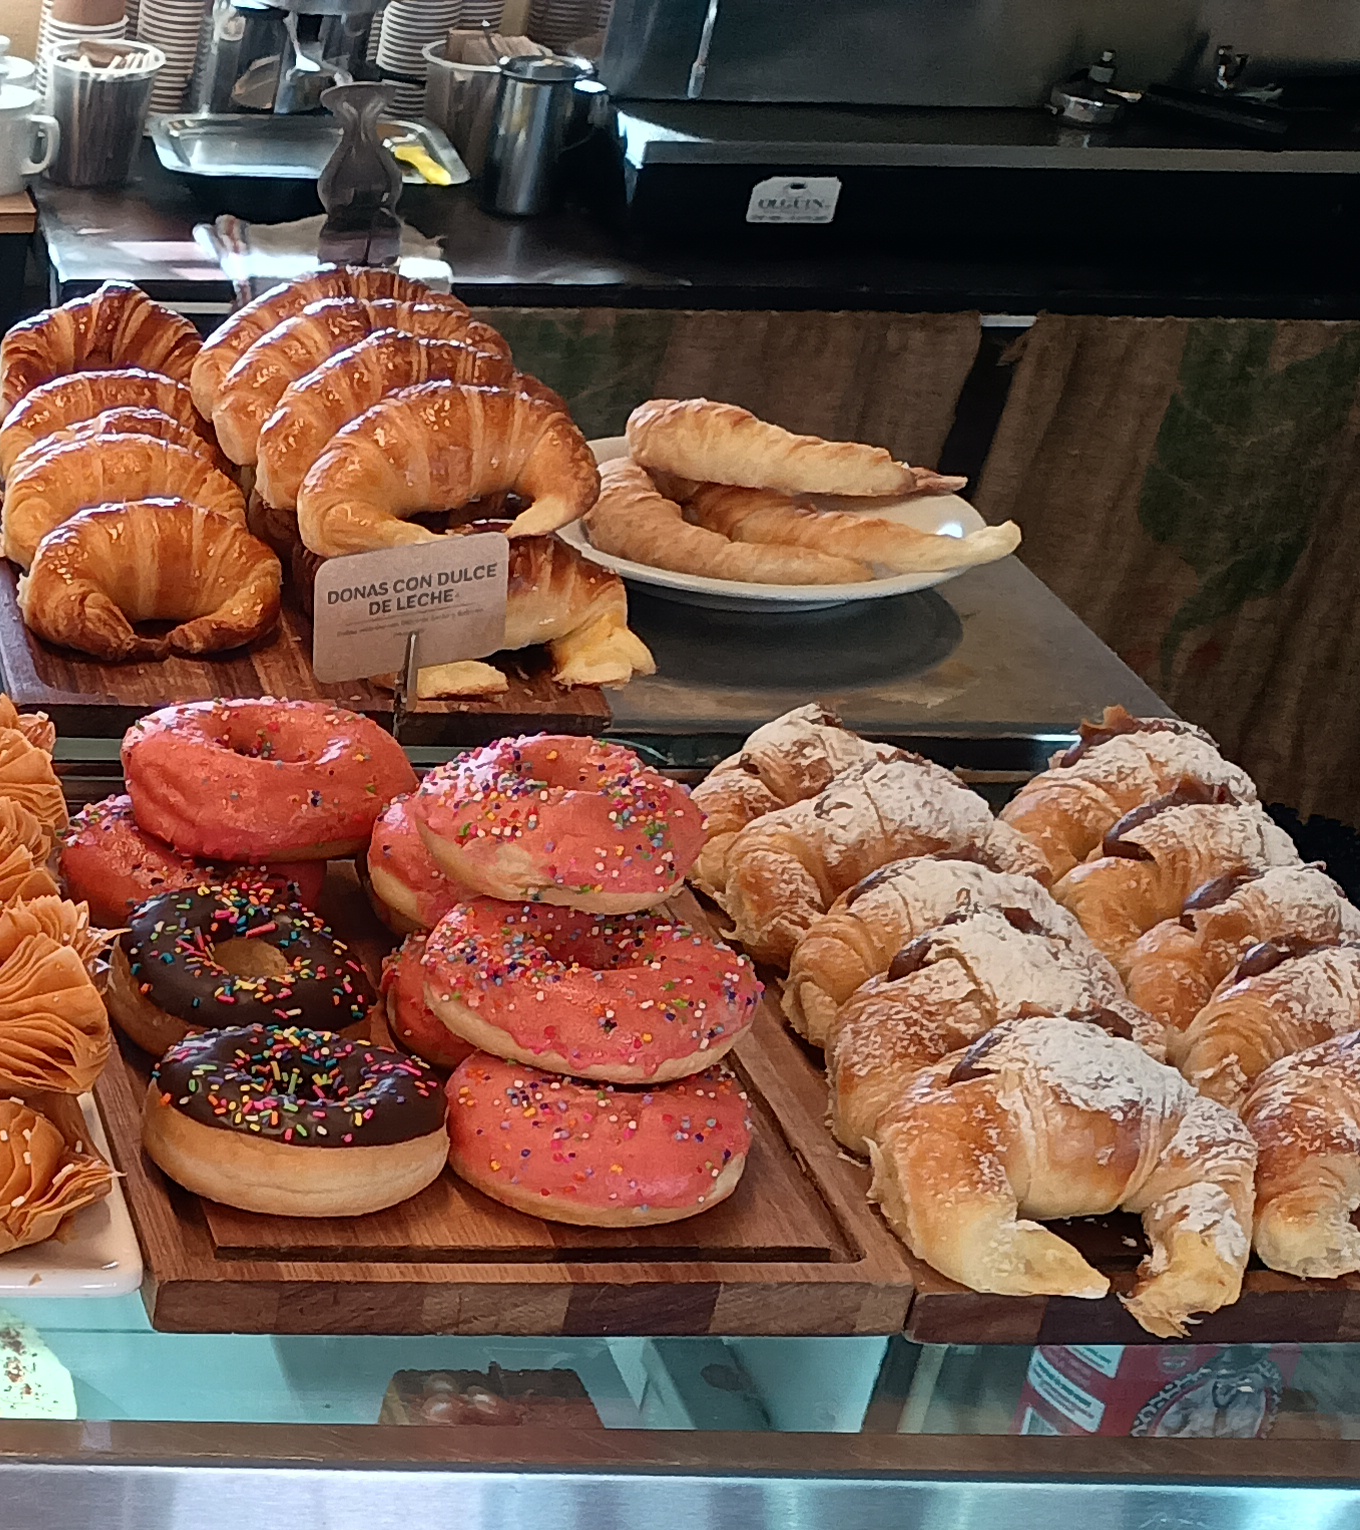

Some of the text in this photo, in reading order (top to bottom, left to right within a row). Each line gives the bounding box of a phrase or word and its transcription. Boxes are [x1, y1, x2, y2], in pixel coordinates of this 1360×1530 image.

[327, 562, 499, 605] DONAS CON DULCE
[368, 588, 455, 616] DE LECHE
